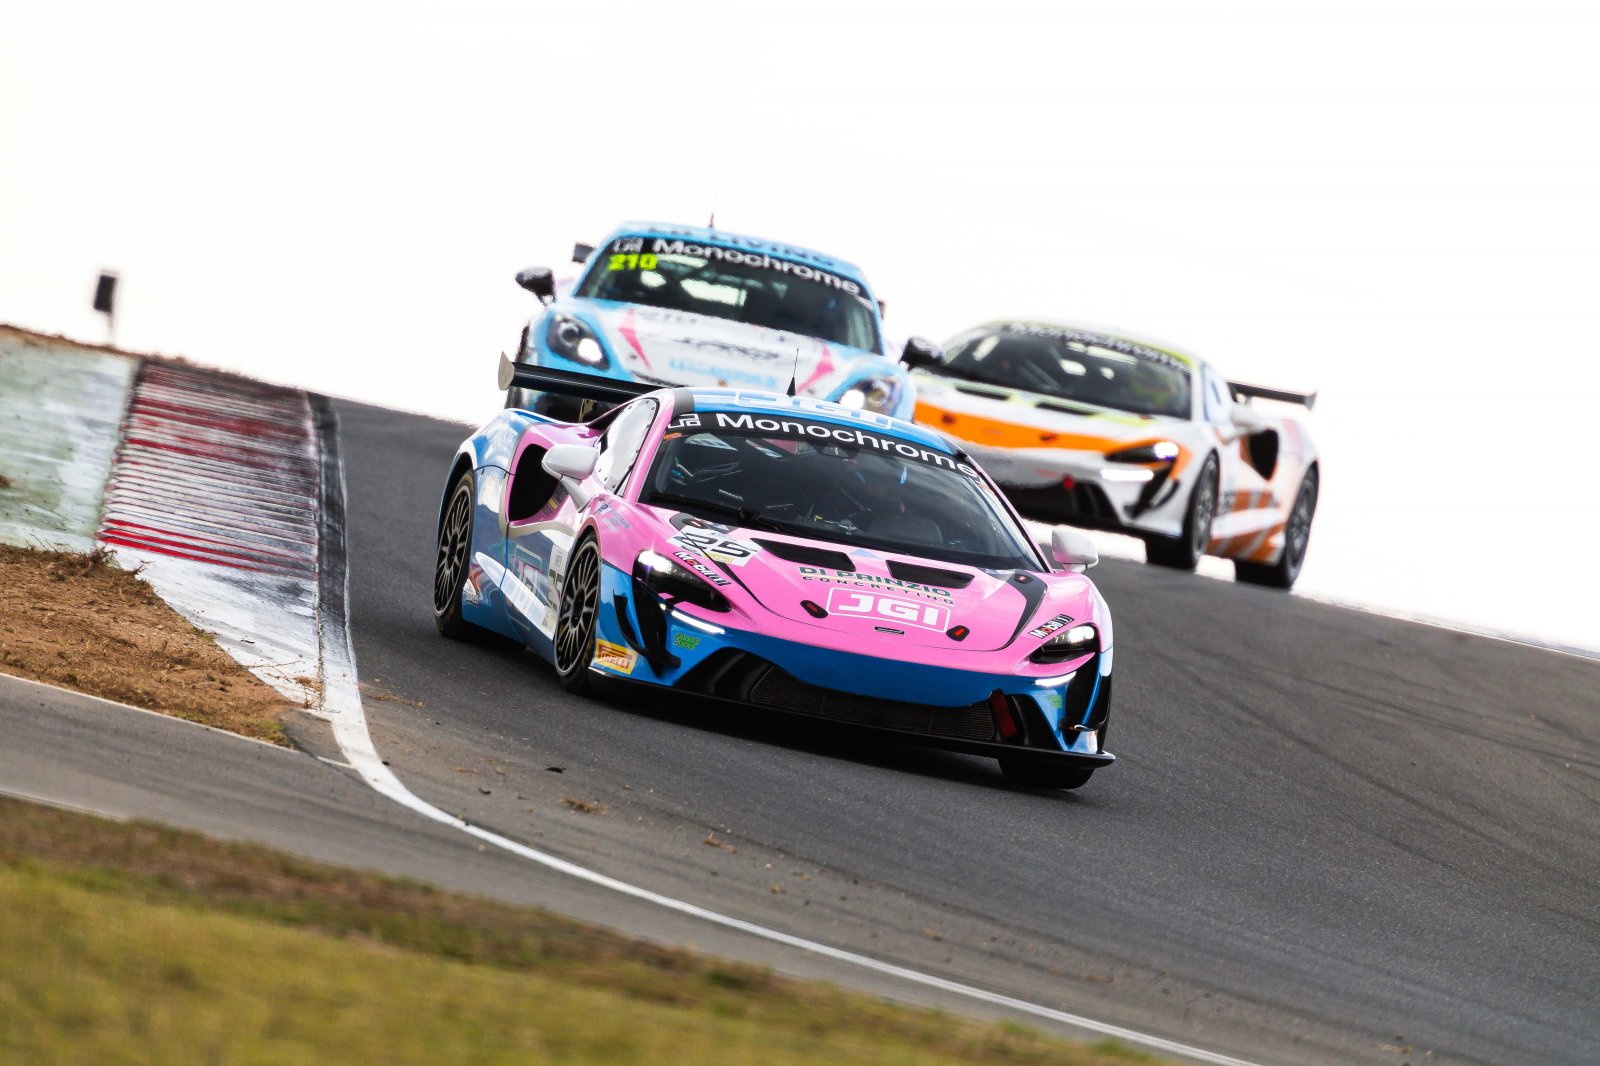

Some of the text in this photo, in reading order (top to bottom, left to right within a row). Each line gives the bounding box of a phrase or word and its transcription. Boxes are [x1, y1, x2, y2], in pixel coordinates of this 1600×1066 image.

[608, 253, 658, 271] 210
[653, 238, 860, 296] Monochrome
[716, 413, 978, 477] Monochrome
[672, 532, 759, 558] 25
[799, 566, 951, 597] DI PRINZIO
[802, 576, 954, 604] CONCRETING
[838, 594, 939, 626] JGI
